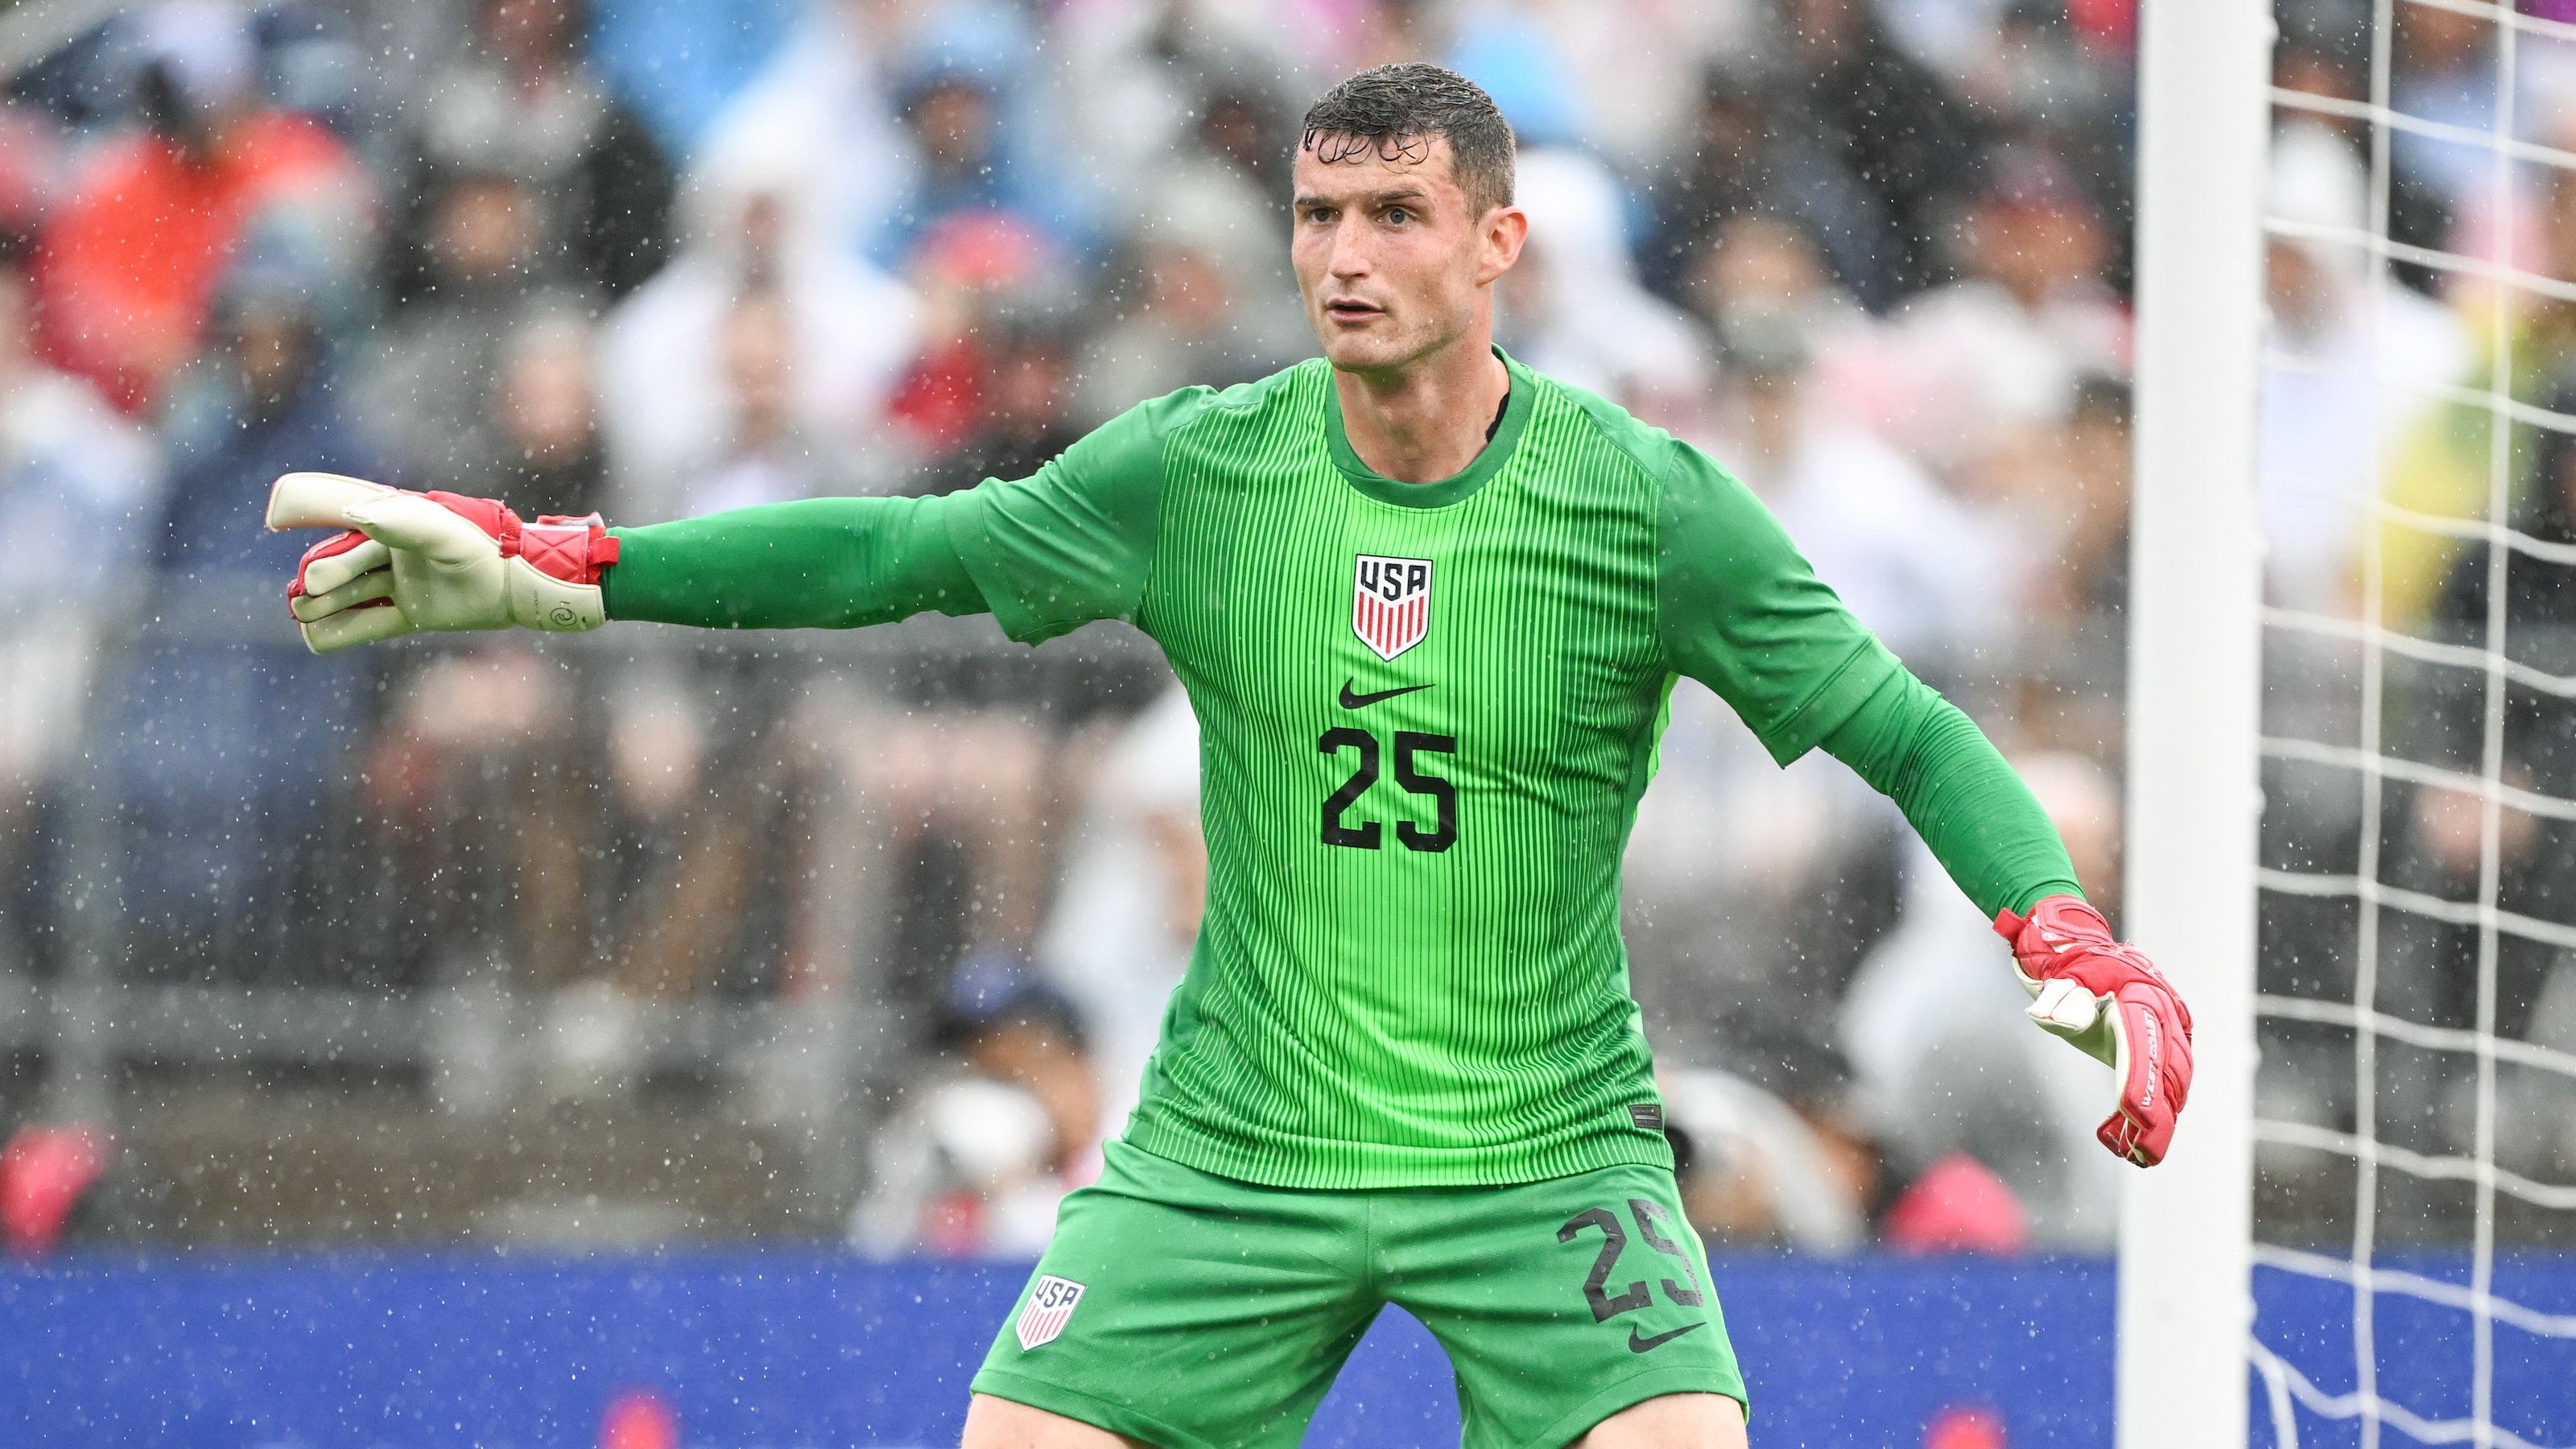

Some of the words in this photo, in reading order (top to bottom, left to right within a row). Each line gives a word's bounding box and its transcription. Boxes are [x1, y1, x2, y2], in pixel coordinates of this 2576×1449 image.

[1360, 561, 1426, 601] USA
[1319, 727, 1457, 852] 25
[2142, 1008, 2158, 1063] COAST
[2140, 1059, 2157, 1107] WEST
[1556, 1199, 1704, 1323] 25
[1035, 1279, 1080, 1308] USA
